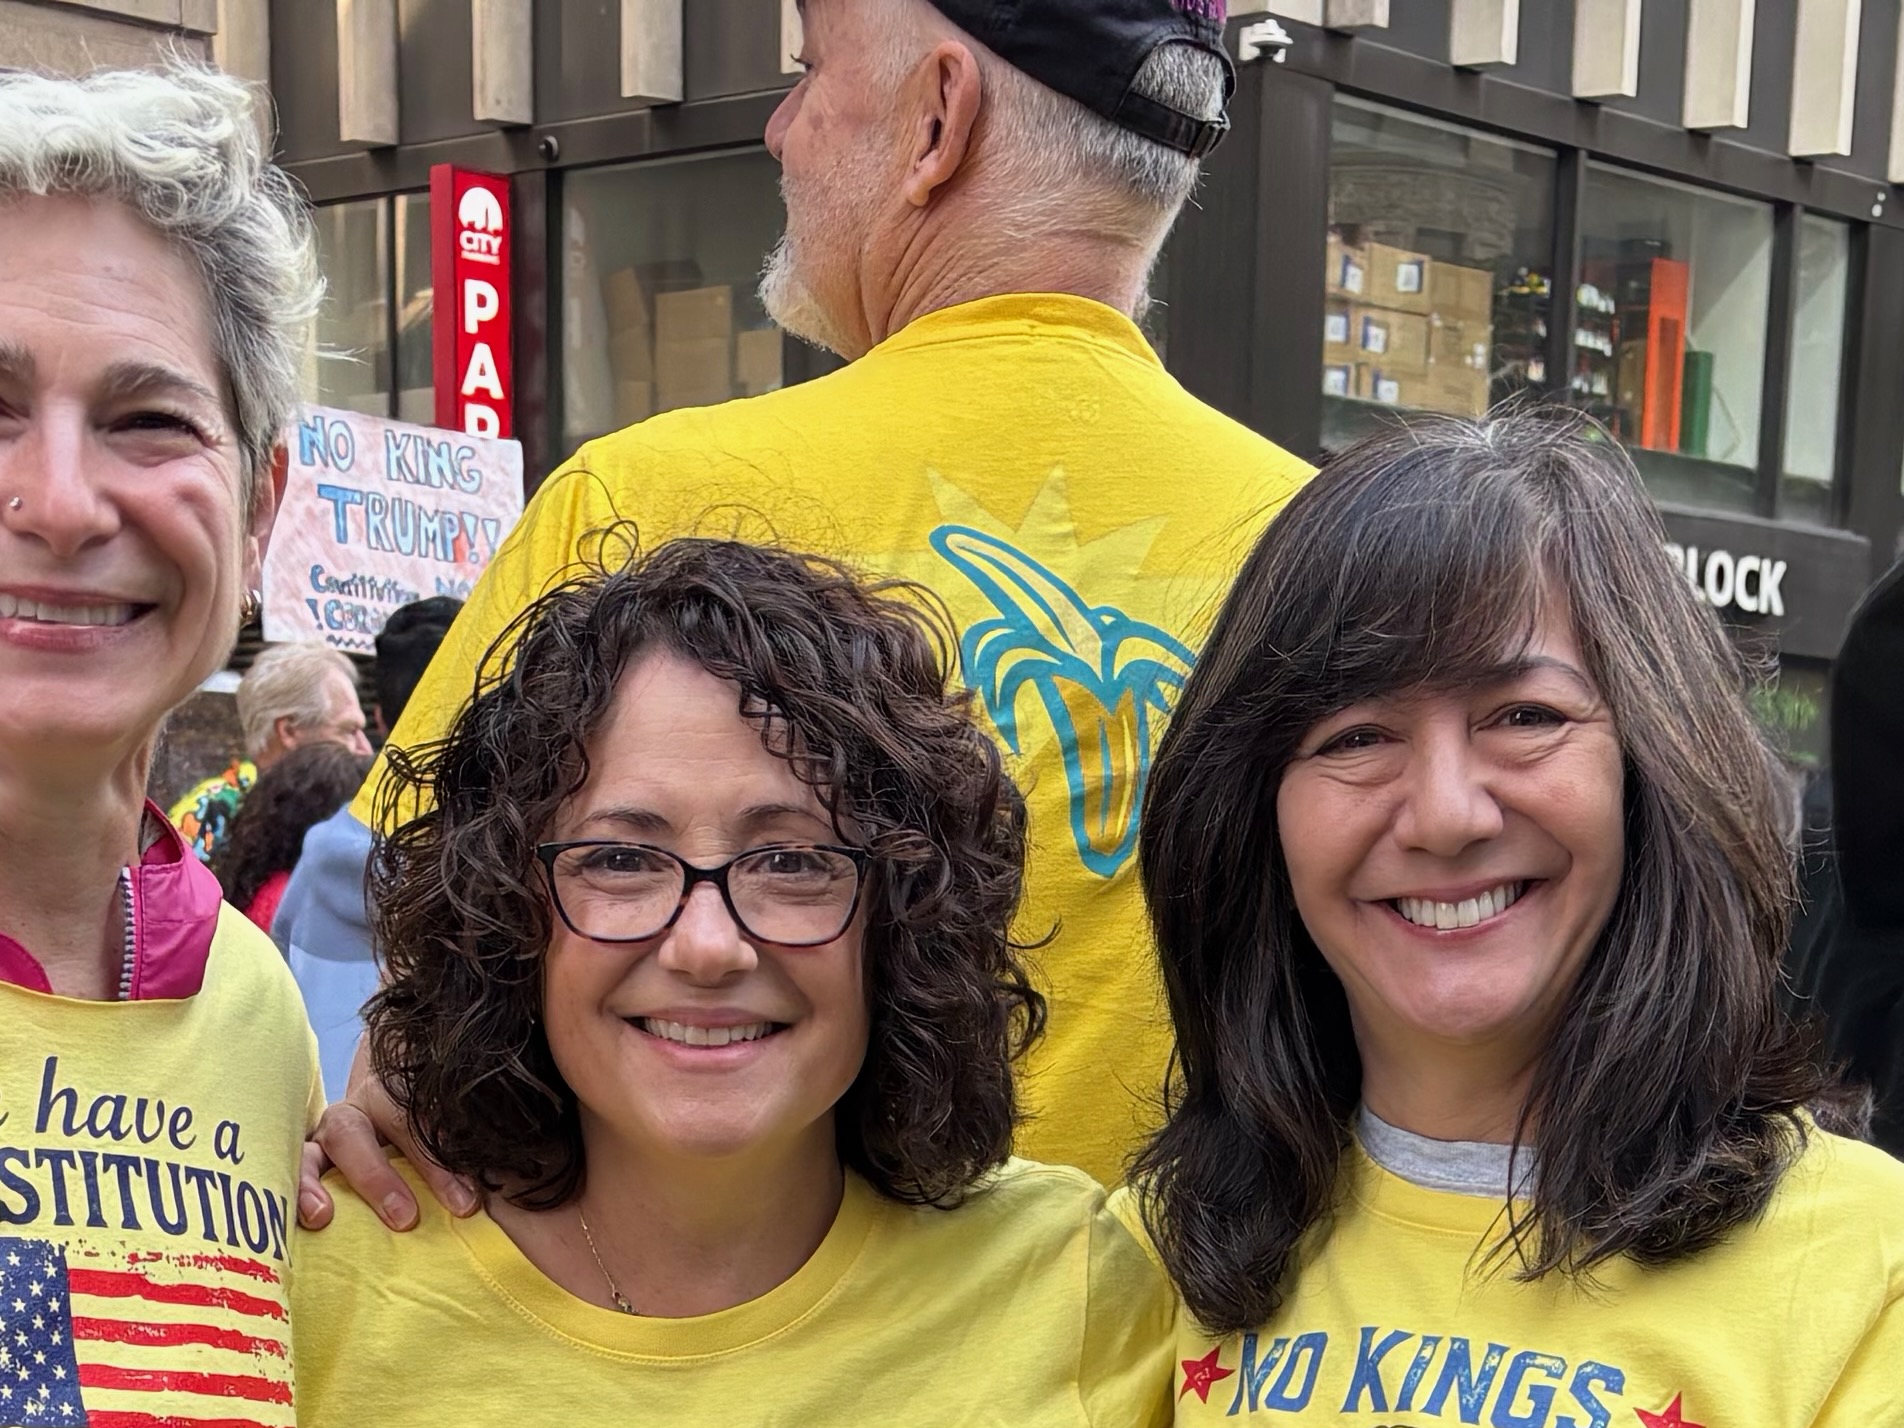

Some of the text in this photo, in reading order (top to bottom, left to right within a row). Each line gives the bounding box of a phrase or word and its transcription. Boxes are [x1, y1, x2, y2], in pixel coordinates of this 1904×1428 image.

[459, 230, 503, 255] CITY
[298, 416, 482, 494] NO KING
[36, 1054, 197, 1151] have
[213, 1120, 245, 1165] a
[1227, 1329, 1328, 1418] NO
